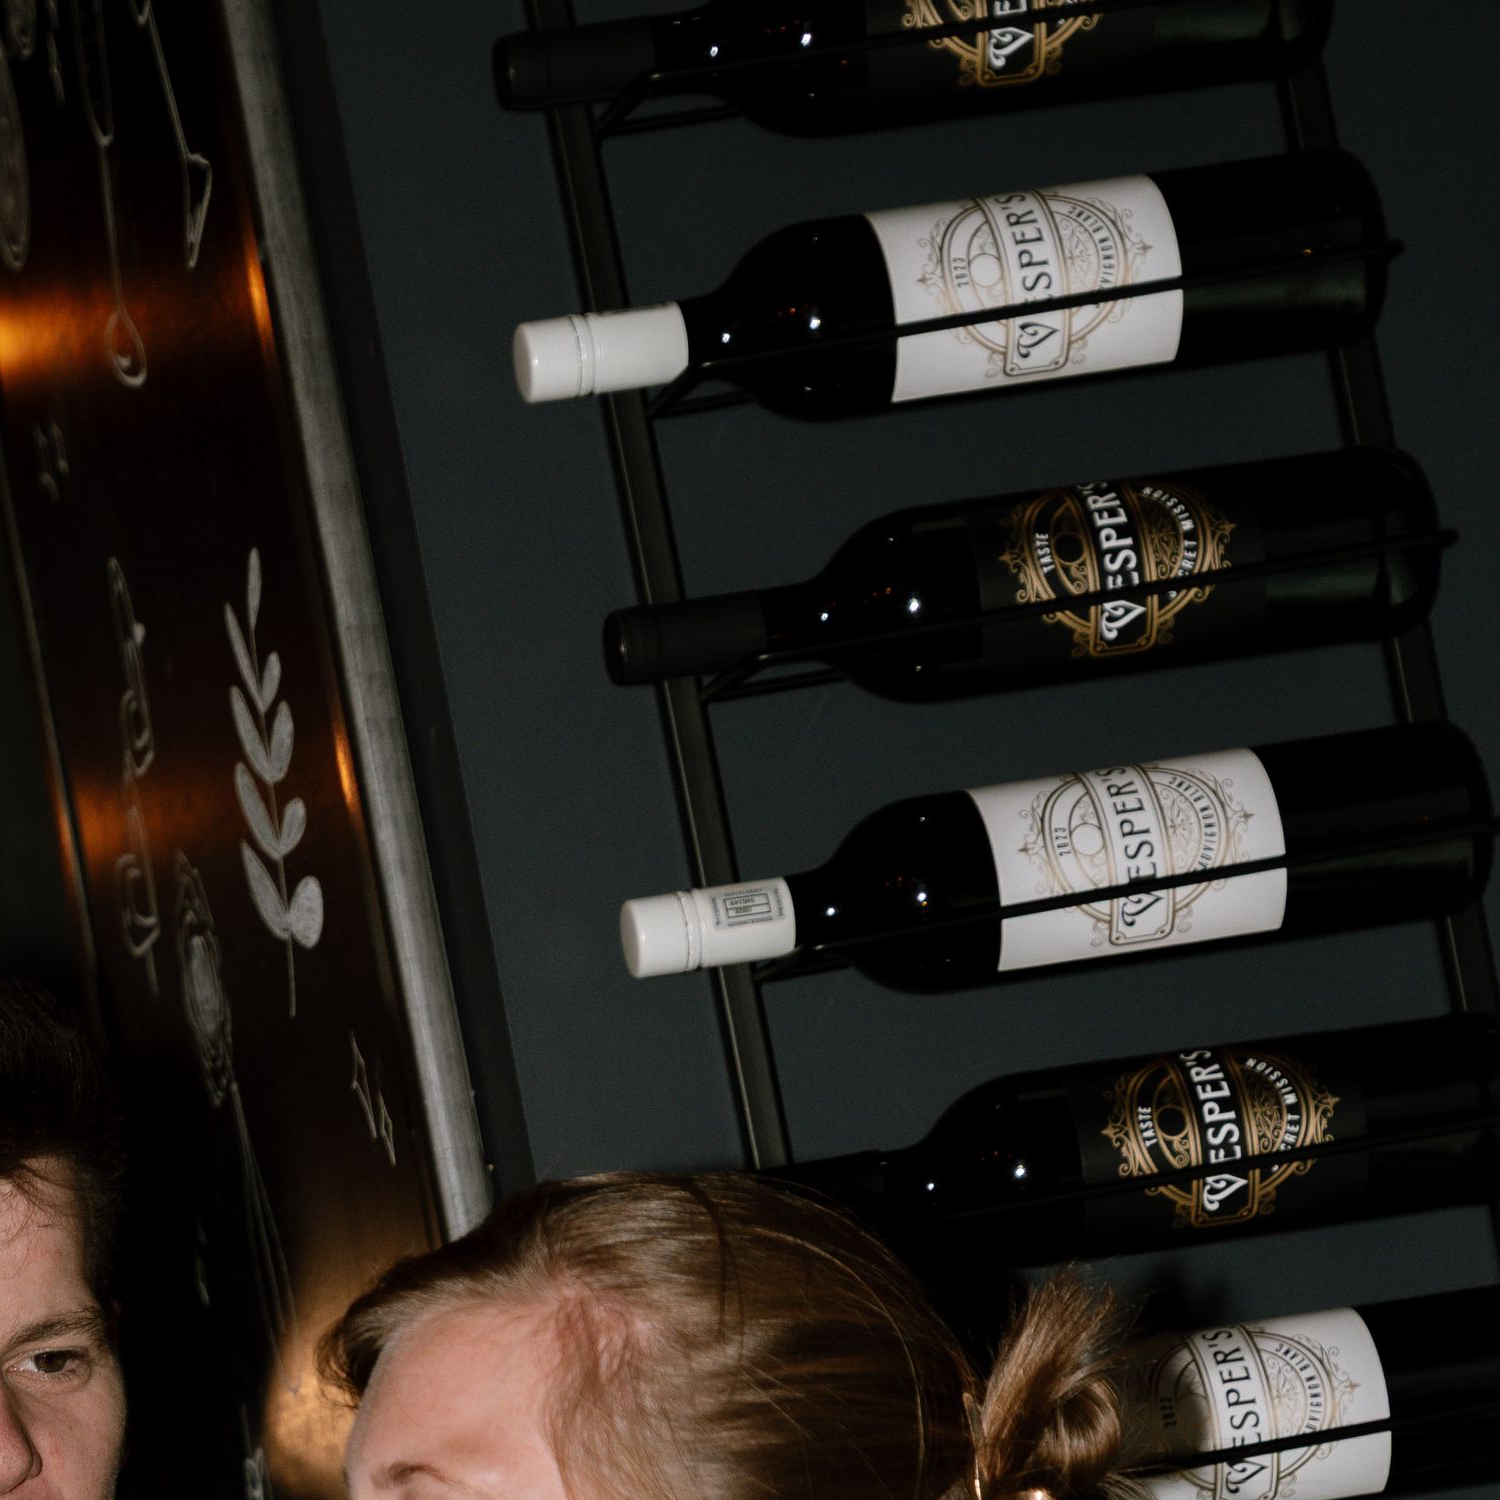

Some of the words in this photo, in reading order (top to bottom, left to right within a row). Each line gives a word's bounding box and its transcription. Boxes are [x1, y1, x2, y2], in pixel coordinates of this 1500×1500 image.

[953, 257, 970, 288] 2023
[994, 192, 1059, 359] VSPER'S
[1141, 486, 1195, 533] MISSION
[1033, 532, 1056, 575] TASTE
[1168, 776, 1205, 803] BLANC
[1054, 827, 1071, 857] 2023
[1194, 805, 1217, 872] AUVIGNON
[1245, 1057, 1298, 1105] MISSION
[1137, 1105, 1158, 1149] TASTE
[1179, 1050, 1249, 1212] VESPER'S
[1275, 1342, 1311, 1372] BLANC
